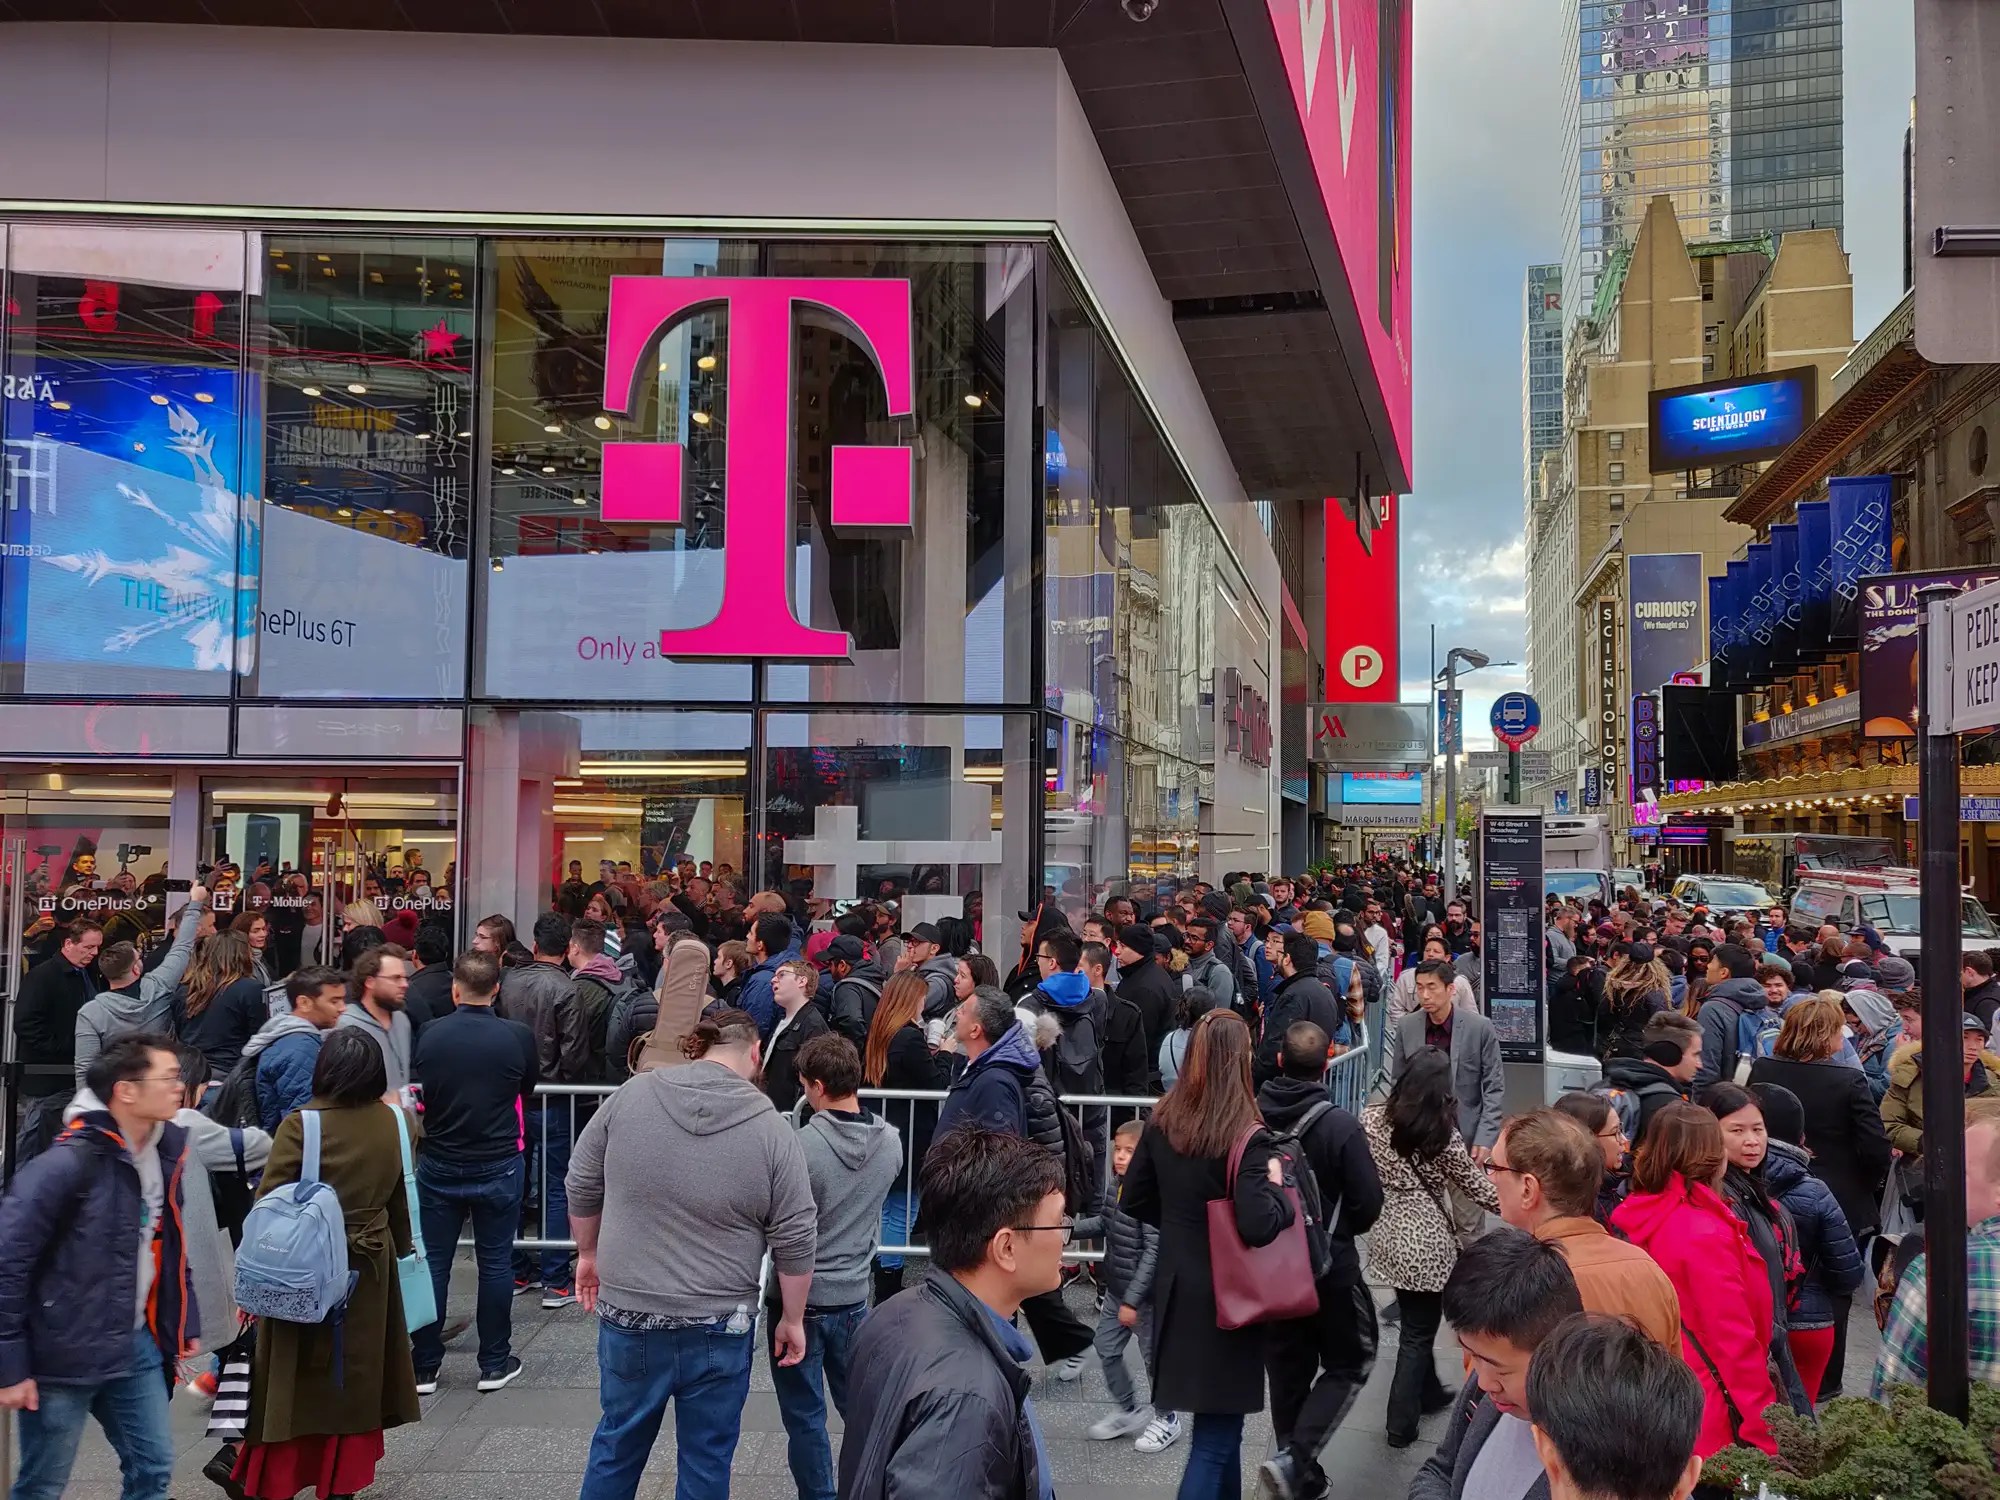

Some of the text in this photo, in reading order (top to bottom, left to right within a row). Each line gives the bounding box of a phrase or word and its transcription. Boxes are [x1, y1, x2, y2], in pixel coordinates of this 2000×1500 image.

[1693, 408, 1767, 430] SCIENTOLOGY
[1709, 422, 1749, 432] NETWORK
[1833, 501, 1884, 560] BEEP
[120, 577, 226, 621] THE NEW
[1635, 600, 1697, 619] CURIOUS?
[1865, 607, 1918, 618] THE DONN
[331, 619, 356, 647] 6T
[1656, 620, 1677, 631] thought
[578, 636, 662, 665] Only a
[1354, 655, 1372, 680] P
[1967, 661, 1999, 708] KEEP
[1603, 608, 1616, 793] SCIENTOLOGY
[1345, 815, 1419, 824] MARQUIS THEATRE
[1508, 837, 1529, 845] Square
[61, 895, 131, 911] OnePlus
[392, 896, 451, 911] OnePlus
